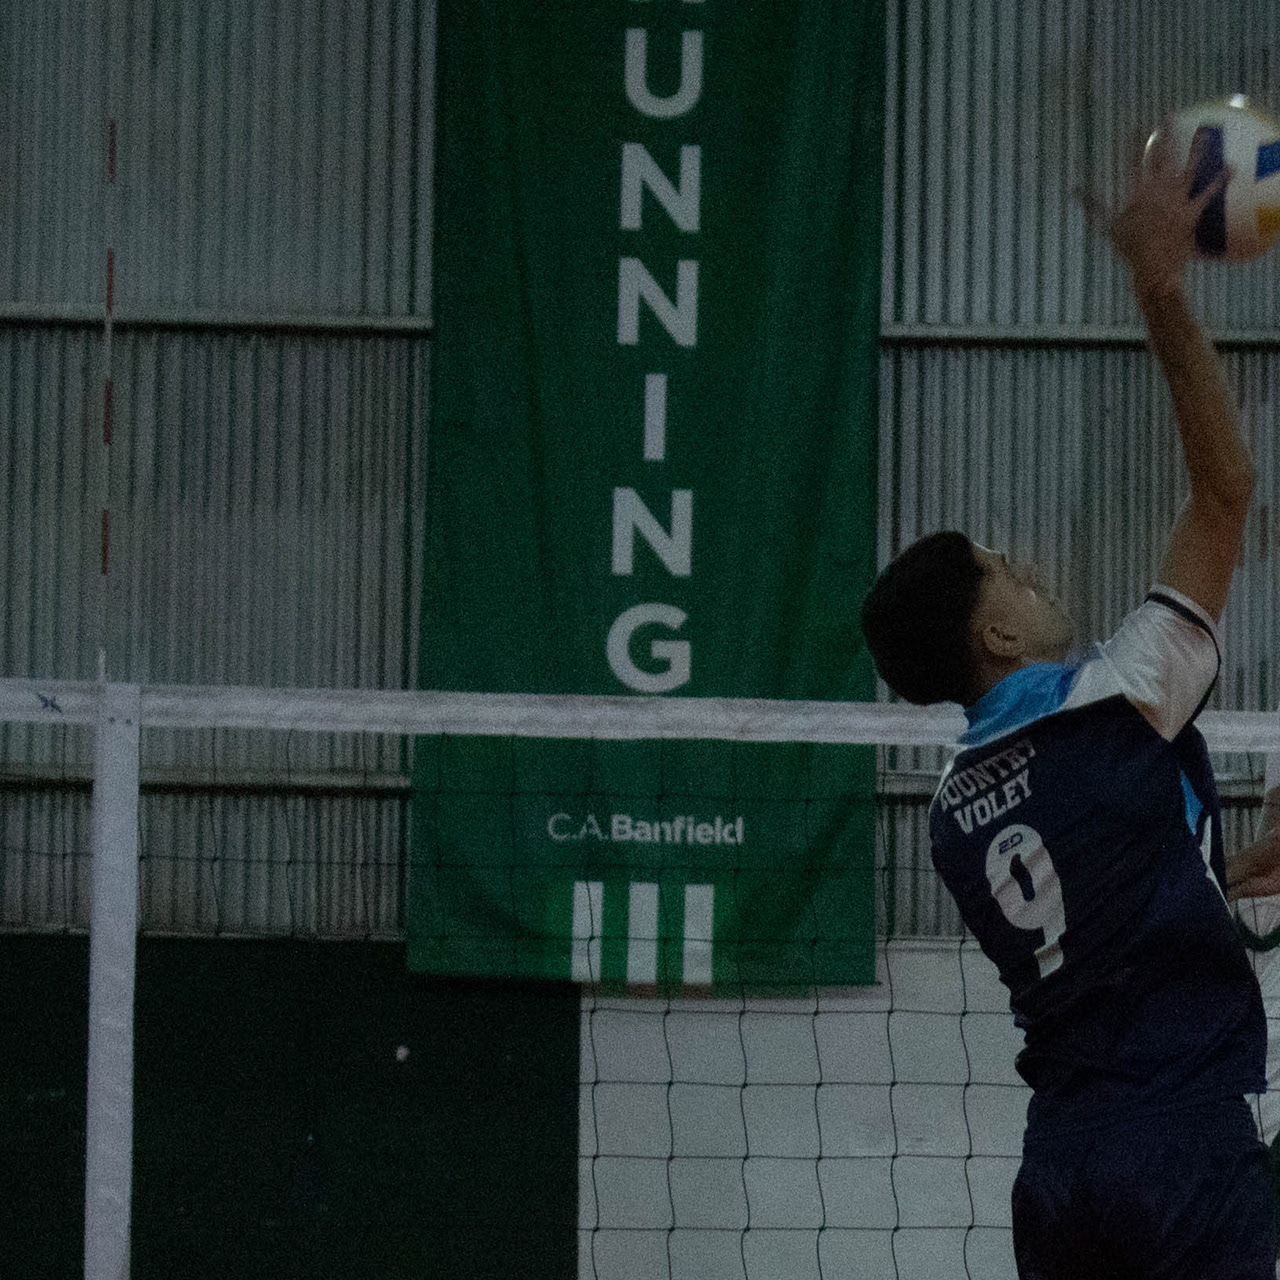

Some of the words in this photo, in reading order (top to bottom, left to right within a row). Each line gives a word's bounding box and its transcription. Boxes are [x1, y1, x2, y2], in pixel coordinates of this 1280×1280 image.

[605, 0, 705, 693] UNNING
[953, 768, 1032, 834] VOLEY
[986, 823, 1067, 979] 9
